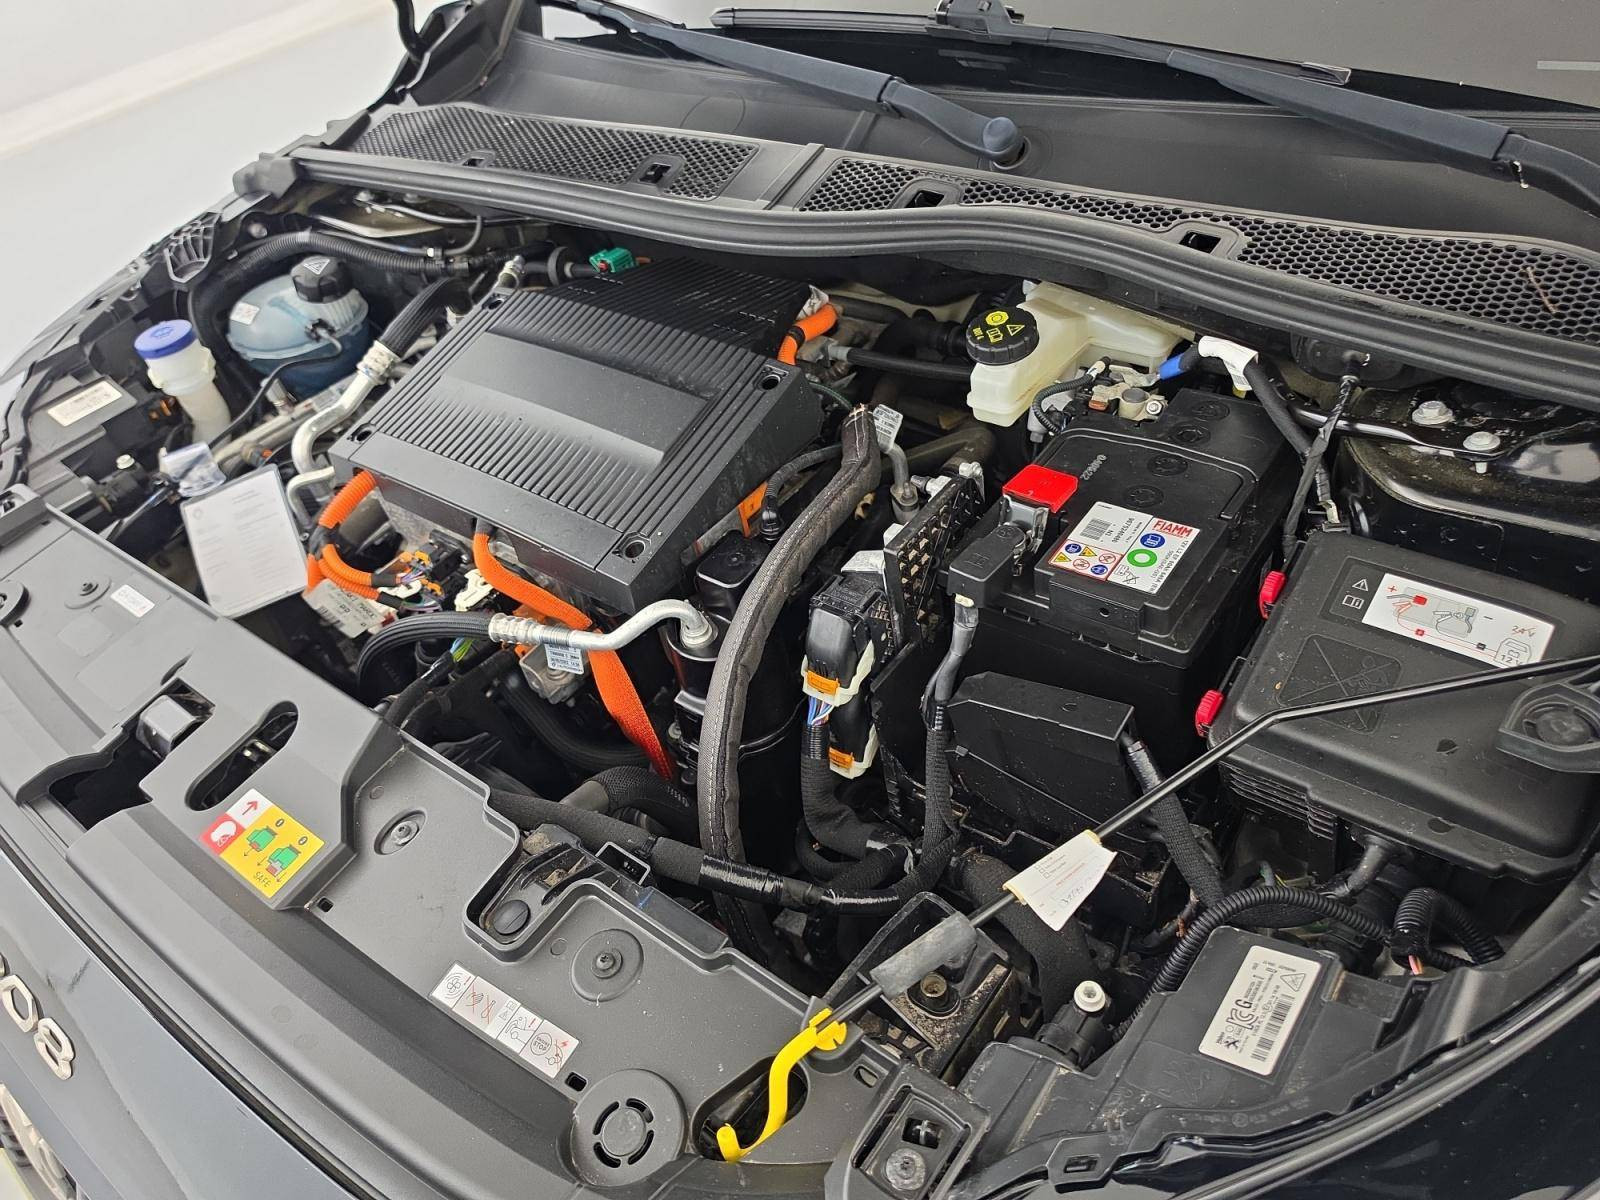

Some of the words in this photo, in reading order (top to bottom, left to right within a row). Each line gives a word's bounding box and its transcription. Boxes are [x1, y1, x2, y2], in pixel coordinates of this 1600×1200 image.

[1152, 520, 1194, 537] FIAMM
[253, 871, 272, 888] SAFE
[0, 953, 76, 1081] 08
[533, 1041, 547, 1051] STOP
